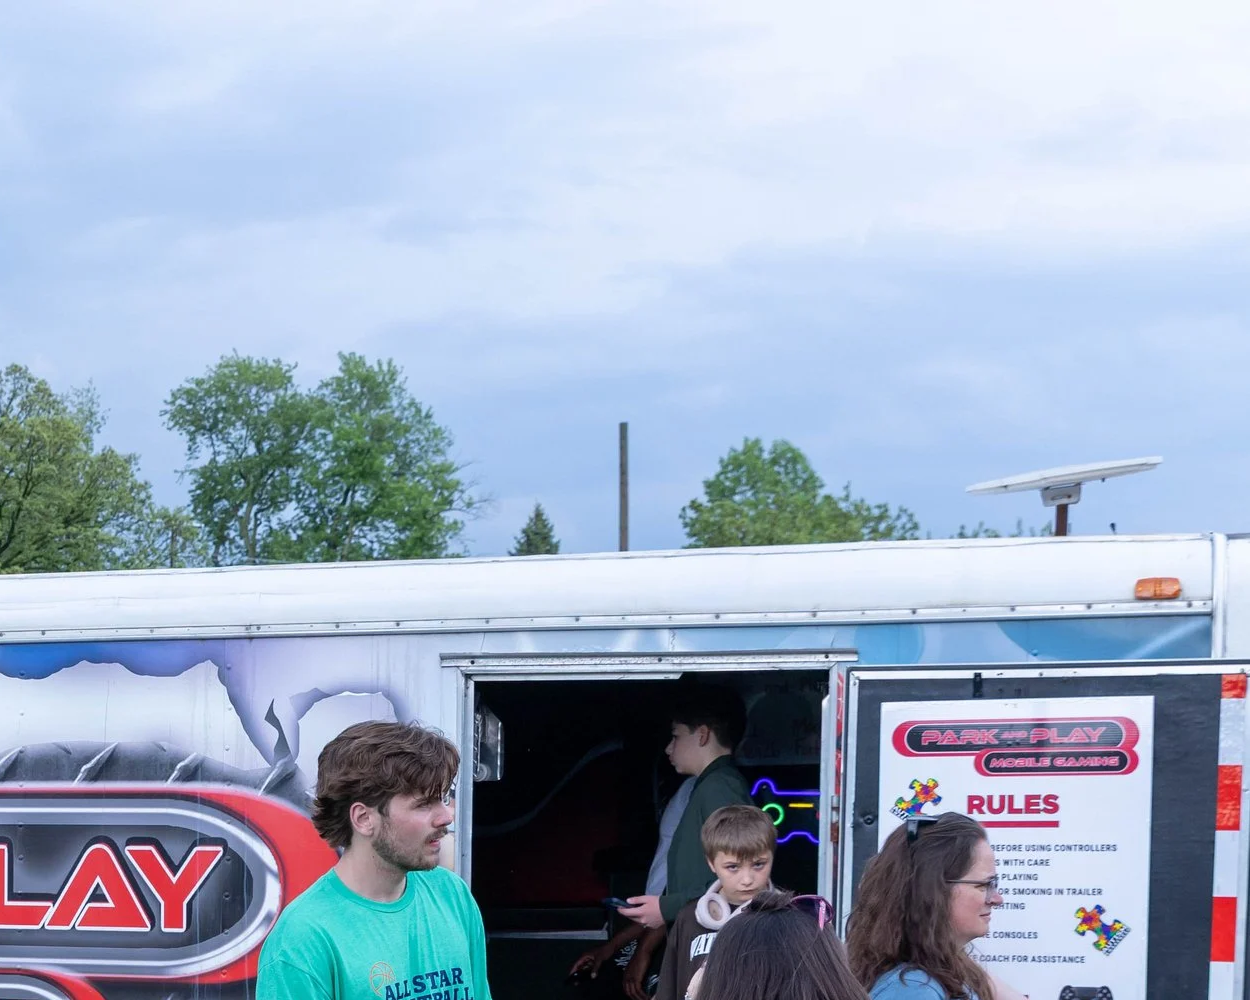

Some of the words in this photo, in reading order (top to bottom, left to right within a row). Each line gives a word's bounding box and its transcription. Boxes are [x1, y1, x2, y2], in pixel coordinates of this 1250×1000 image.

[920, 728, 1000, 745] PARK
[1029, 726, 1107, 744] PLAY
[988, 756, 1051, 768] MOBILE
[1052, 755, 1120, 768] GAMING
[966, 793, 1060, 815] RULES
[990, 844, 1022, 852] BEFORE
[1024, 844, 1051, 852] USING
[1053, 844, 1118, 852] CONTROLLERS
[1002, 859, 1025, 867] WITH
[1026, 859, 1051, 867] CARE
[1000, 873, 1039, 881] PLAYING
[997, 888, 1011, 896] OR
[1012, 888, 1053, 896] SMOKING
[1054, 888, 1064, 896] IN
[1066, 888, 1103, 896] TRAILER
[992, 931, 1039, 940] CONSOLES
[979, 954, 1010, 963] COACH
[1011, 955, 1029, 963] FOR
[1030, 955, 1086, 964] ASSISTANCE
[412, 967, 465, 994] STAR
